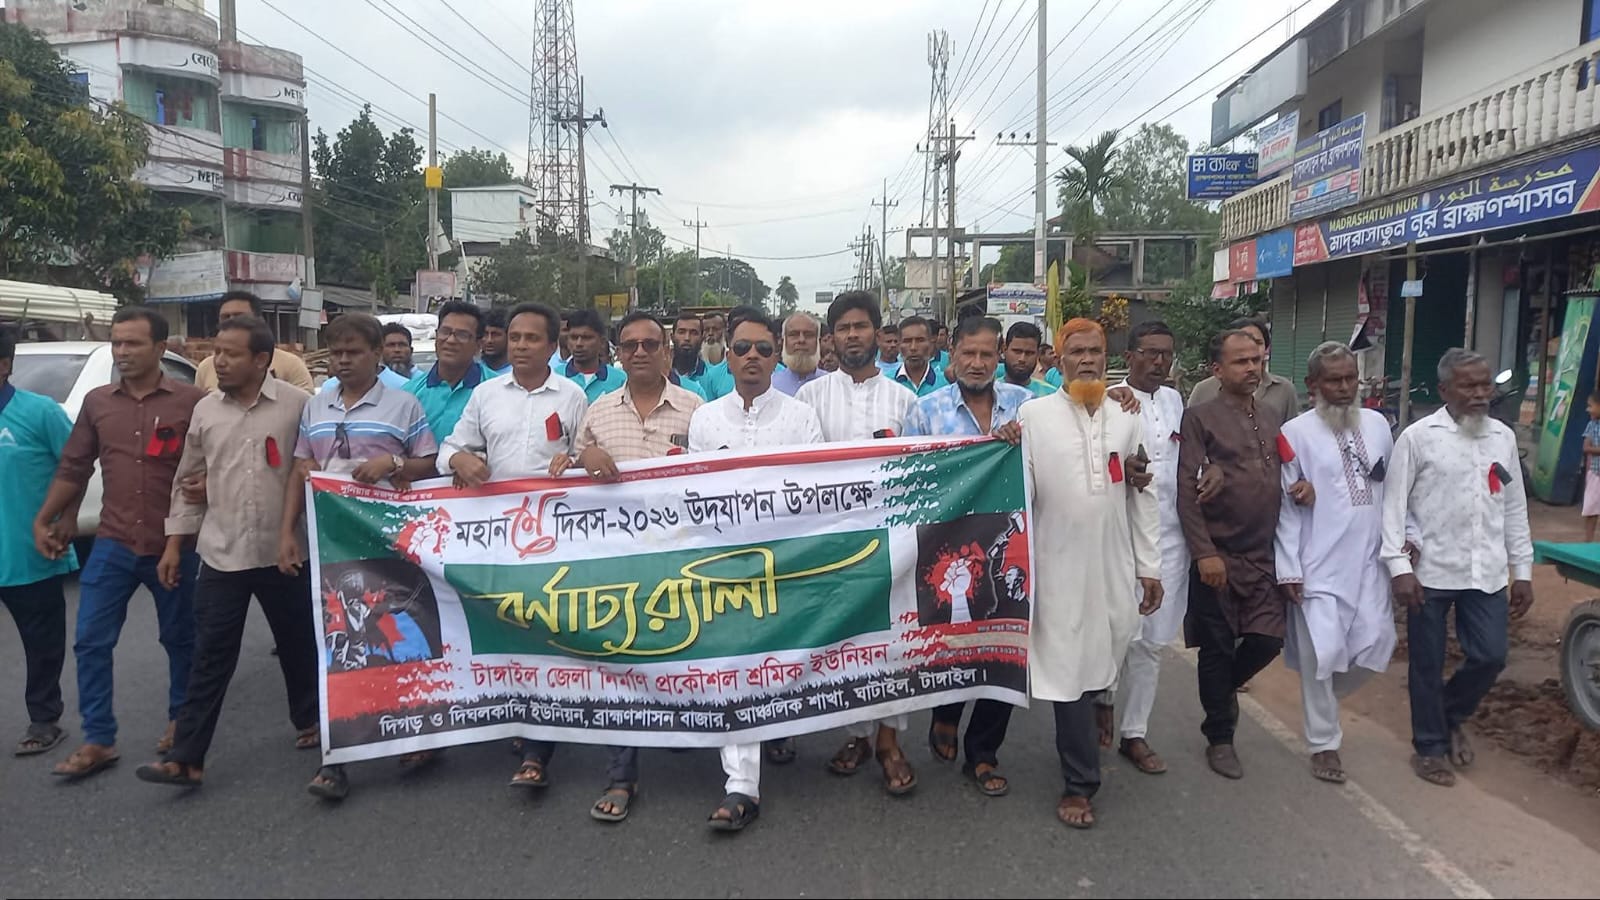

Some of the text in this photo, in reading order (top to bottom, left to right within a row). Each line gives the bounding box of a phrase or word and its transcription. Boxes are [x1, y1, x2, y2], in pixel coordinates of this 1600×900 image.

[1208, 157, 1241, 172] ব্যাংক
[1488, 162, 1574, 194] مدرسة
[1329, 205, 1394, 232] MADRASHATUN
[1396, 196, 1418, 216] NUR
[1410, 209, 1439, 238] নূর
[1442, 179, 1577, 229] ব্রাহ্মণশাসন
[454, 515, 510, 550] মহান
[551, 502, 679, 543] দিবস-২০২৬
[781, 478, 875, 515] উপলক্ষে
[470, 642, 889, 695] টাঙ্গাইল জেলা নির্মাণ প্রকৌশল শ্রমিক ইউনিয়ন
[378, 715, 424, 737] দিগড়
[429, 713, 444, 728] ও
[449, 699, 527, 726] দিঘলকান্দি
[530, 700, 589, 728] ইউনিয়ন,
[592, 707, 674, 728] ব্রাহ্মণশাসন
[679, 709, 731, 731] বাজার,
[735, 698, 803, 724] আঞ্চলিক
[808, 689, 850, 709] শাখা,
[853, 676, 916, 701] ঘাটাইল,
